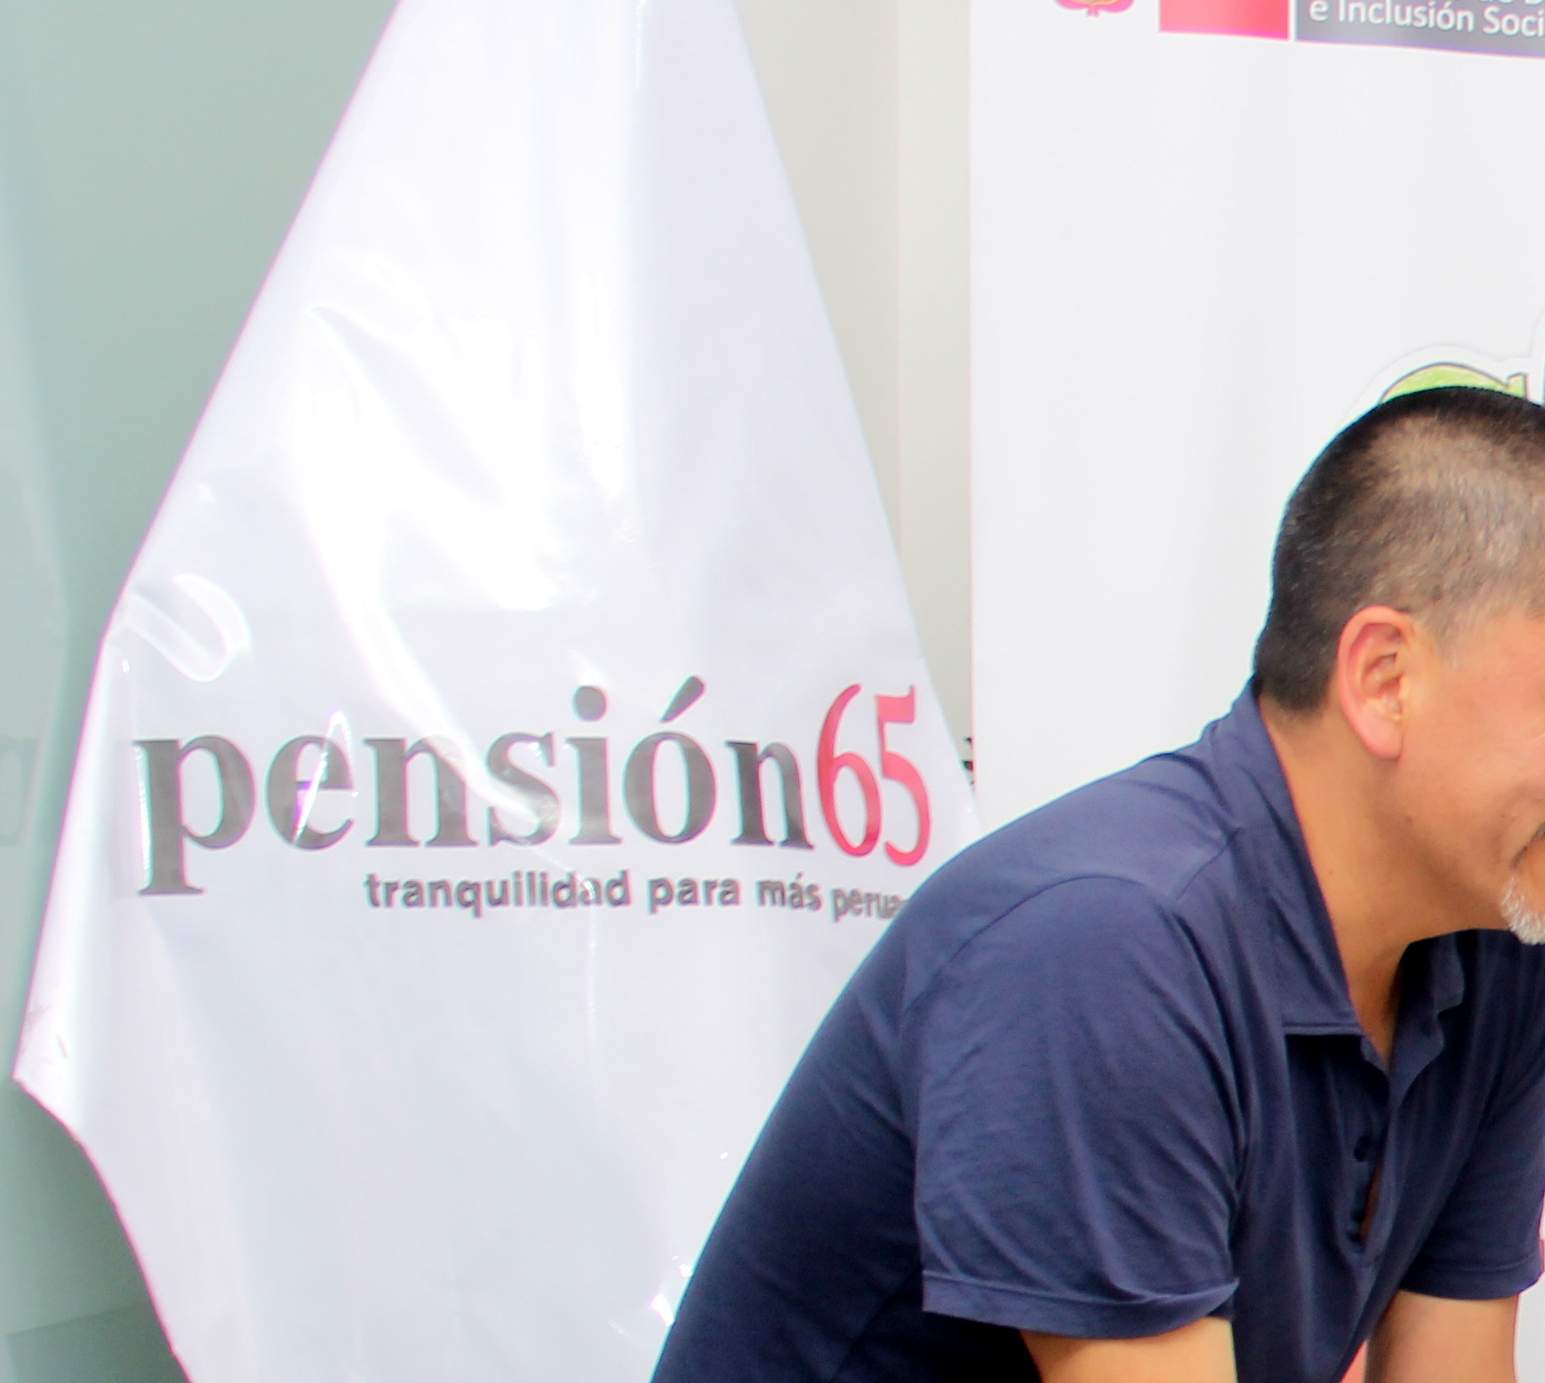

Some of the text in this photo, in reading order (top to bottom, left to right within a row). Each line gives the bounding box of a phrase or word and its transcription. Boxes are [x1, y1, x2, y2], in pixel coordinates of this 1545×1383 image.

[1310, 0, 1328, 20] e
[1338, 0, 1475, 33] Inclusión
[364, 870, 630, 918] tranquilidad
[648, 876, 740, 914] para
[756, 872, 823, 912] más
